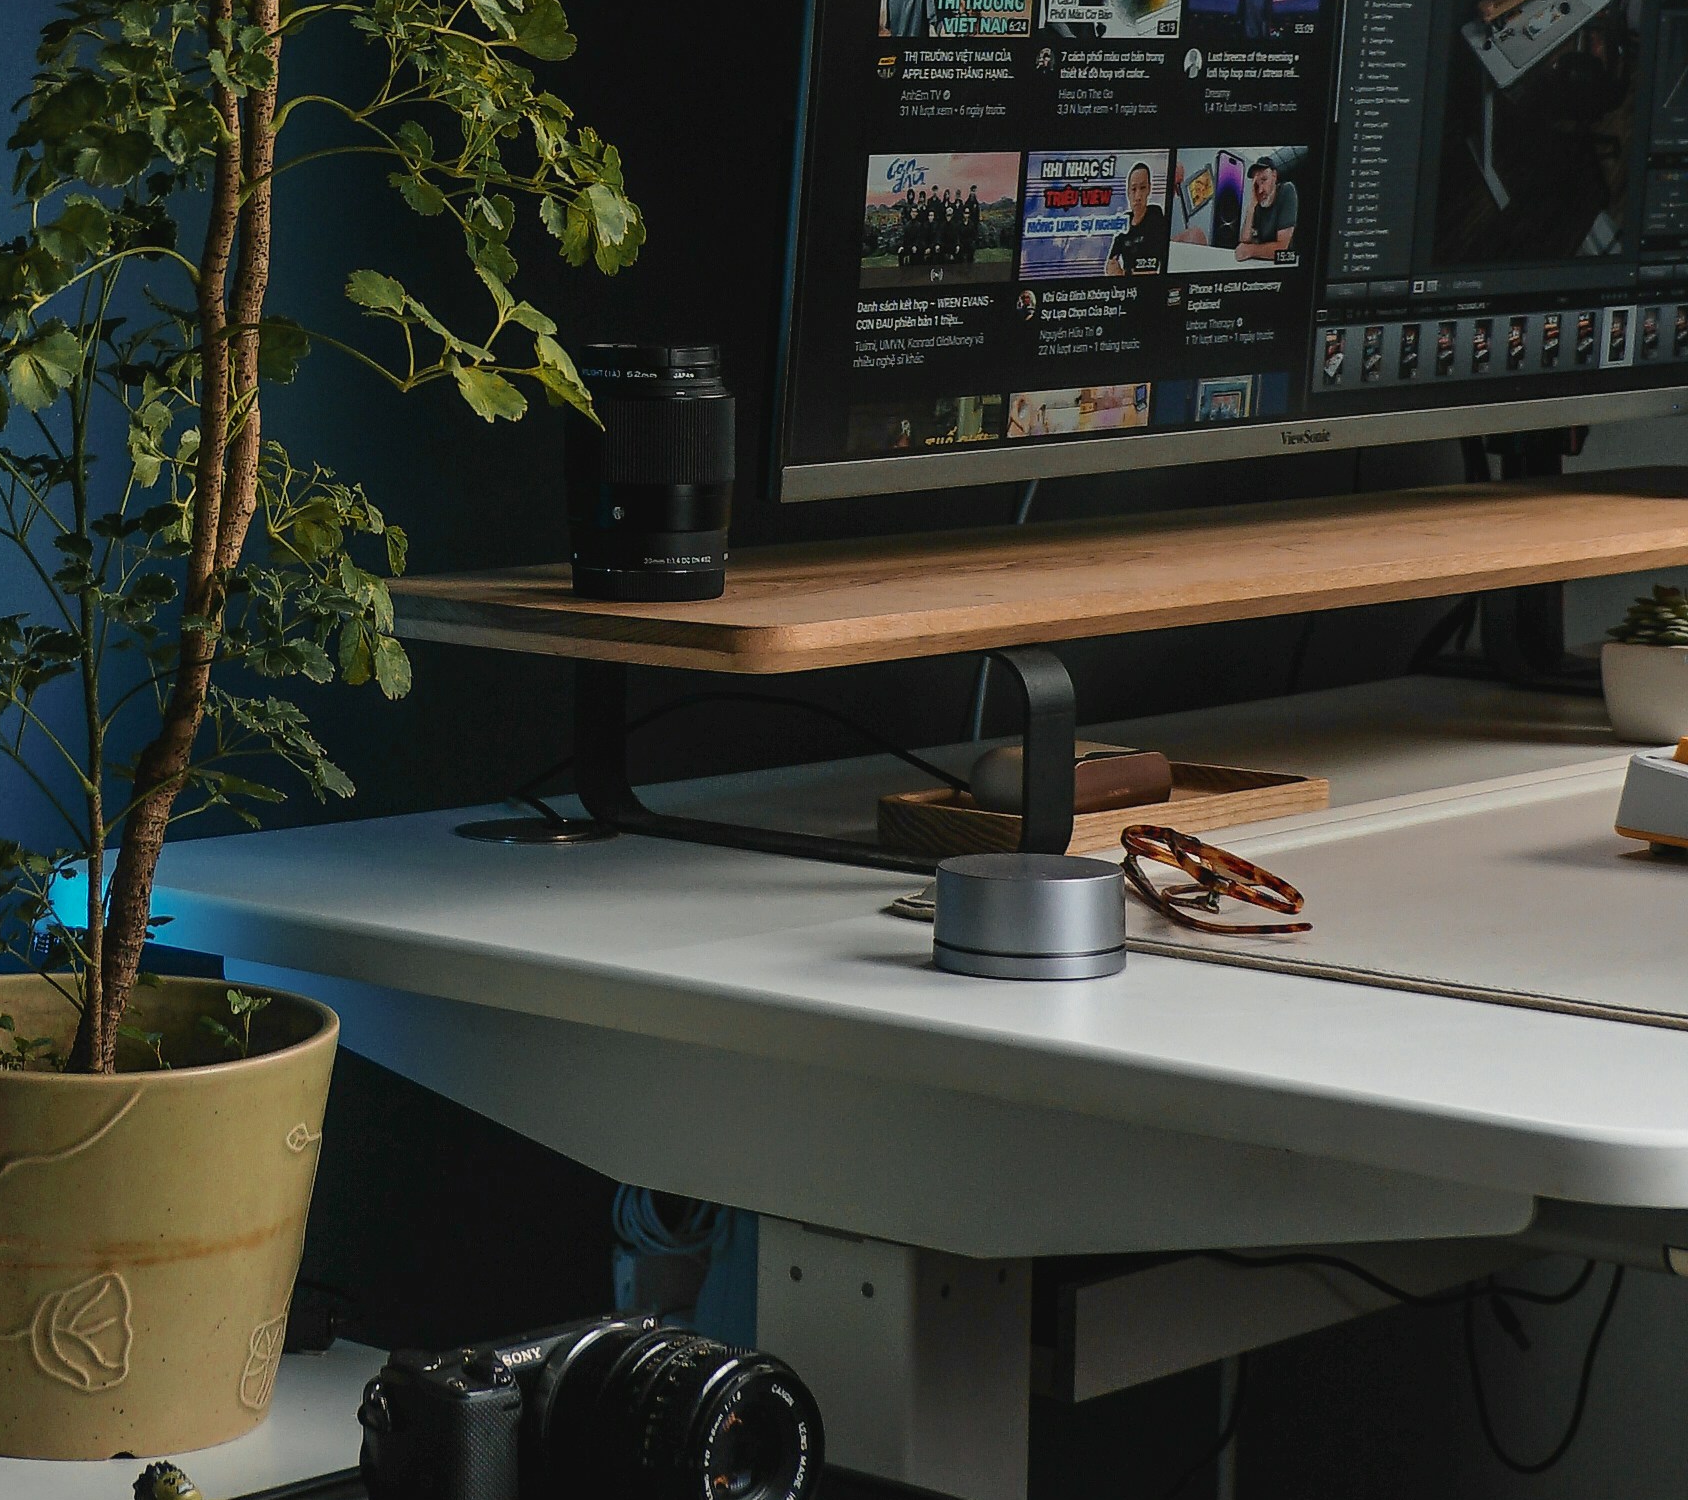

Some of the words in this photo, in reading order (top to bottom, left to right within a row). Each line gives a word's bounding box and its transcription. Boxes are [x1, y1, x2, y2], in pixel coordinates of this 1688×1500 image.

[1008, 21, 1027, 32] 6:24
[901, 69, 930, 80] APPLE
[1042, 161, 1063, 178] KHI
[1081, 188, 1112, 207] VIEW
[1280, 428, 1331, 446] ViewSonic
[501, 1346, 542, 1366] SONY
[793, 1455, 807, 1489] MADE
